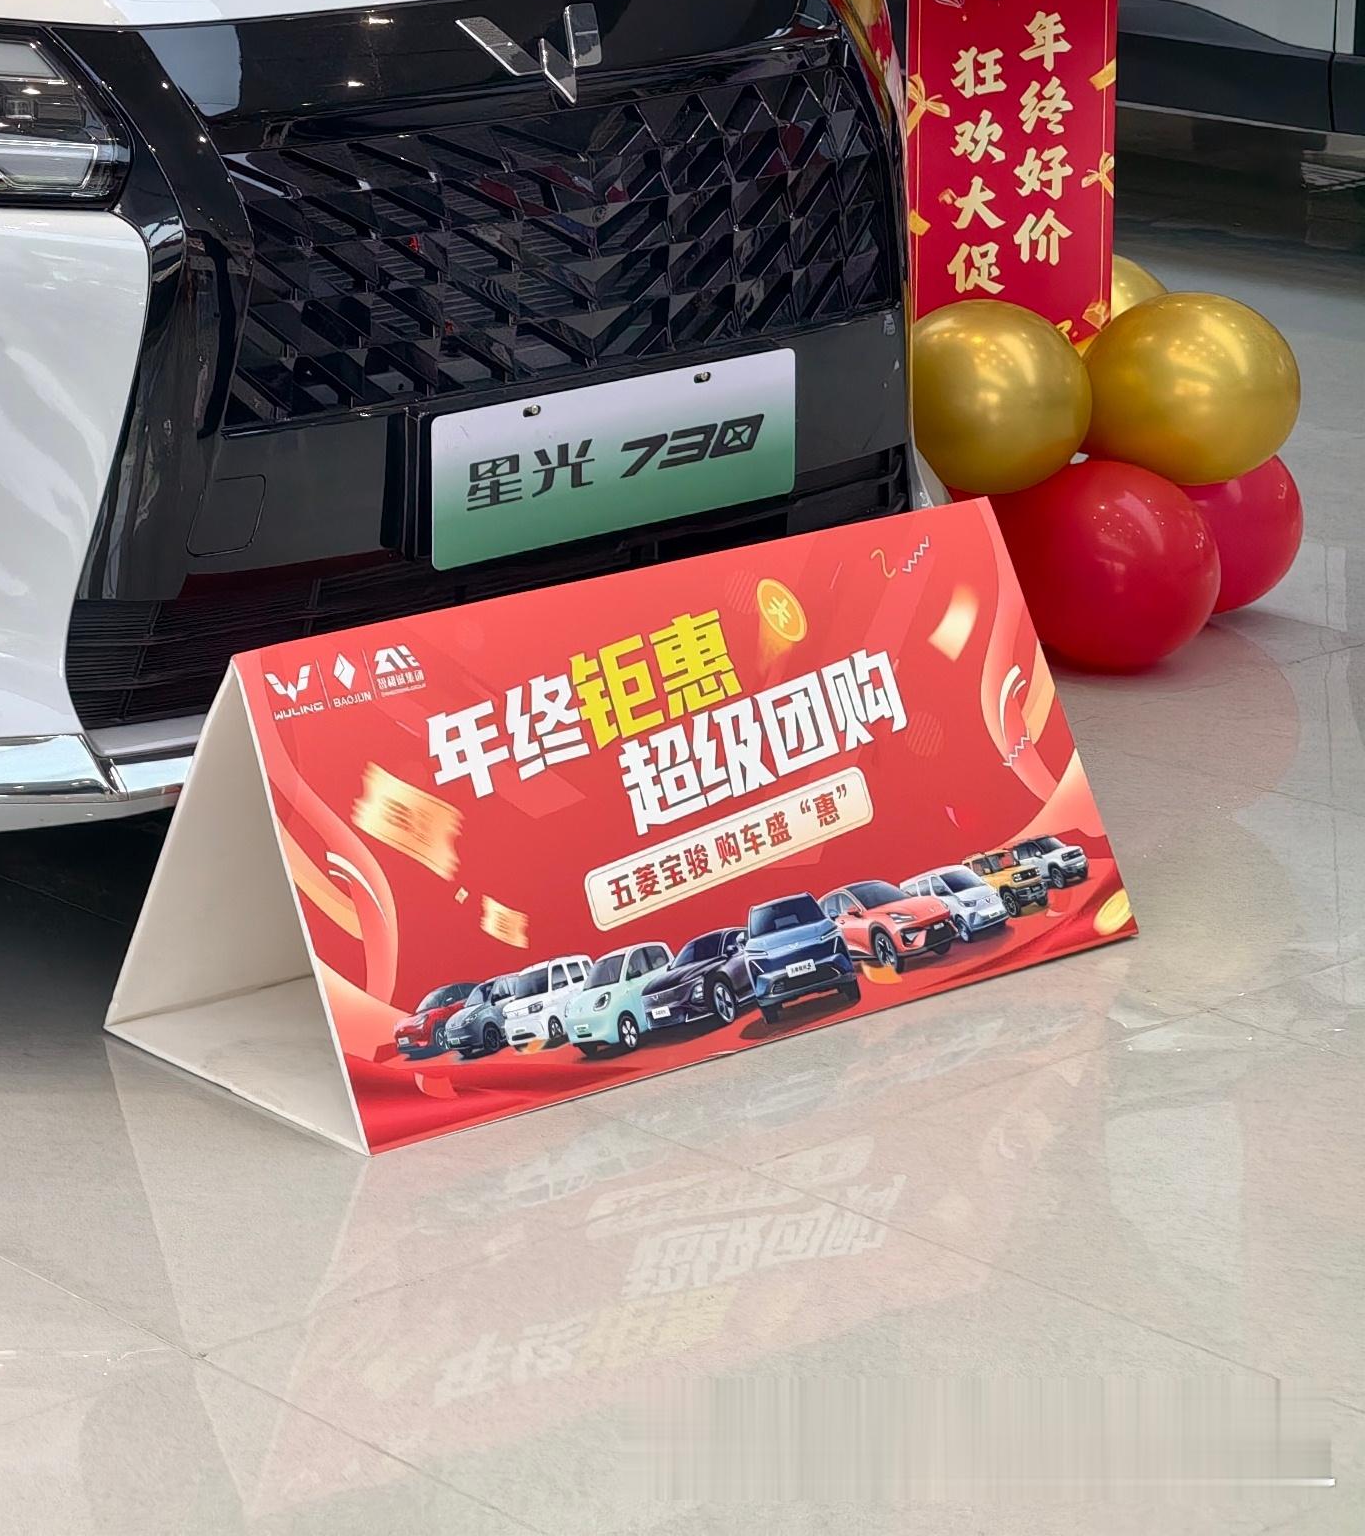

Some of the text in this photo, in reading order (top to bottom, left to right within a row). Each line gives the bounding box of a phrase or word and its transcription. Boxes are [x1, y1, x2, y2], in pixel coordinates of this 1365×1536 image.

[946, 45, 1008, 295] 狂欢大促
[1012, 10, 1074, 266] 年终好价
[620, 413, 764, 478] 730
[273, 701, 325, 721] WULING
[332, 691, 373, 708] BAOJUN
[426, 609, 746, 799] 年终钜惠
[618, 648, 908, 837] 超级团购
[607, 843, 713, 912] 五菱宝骏
